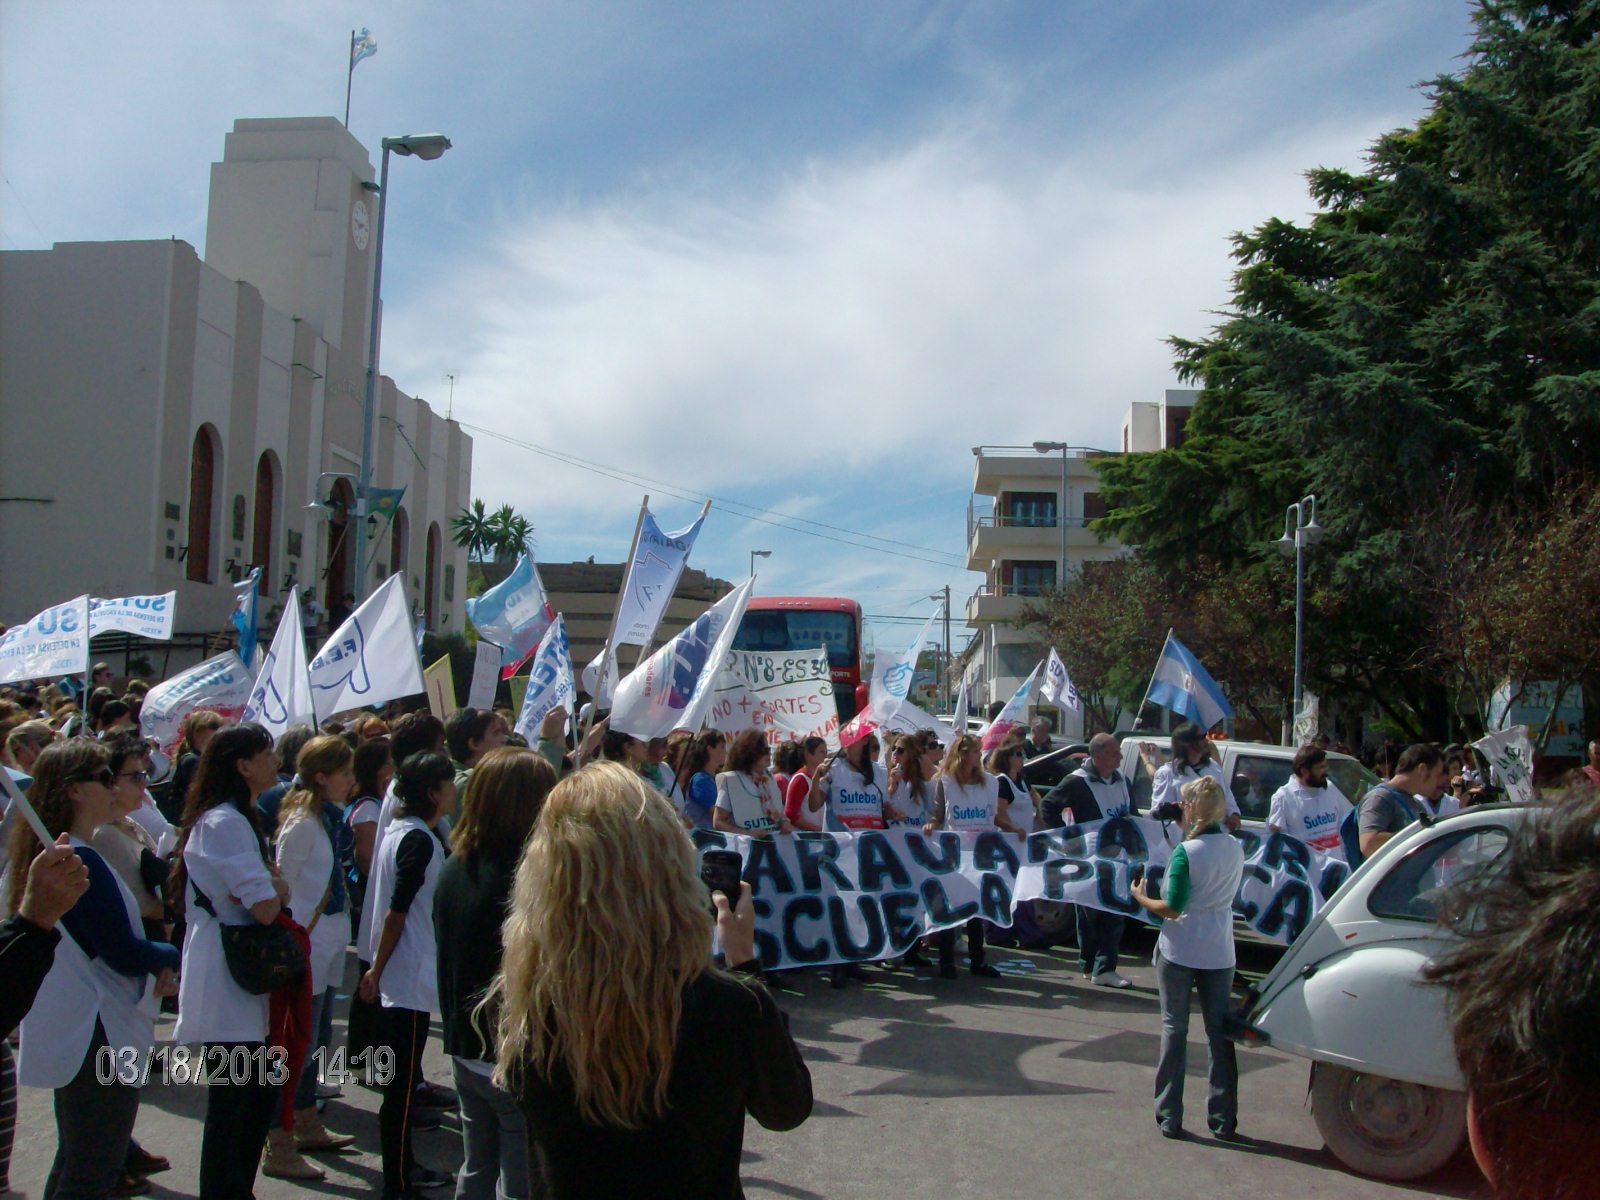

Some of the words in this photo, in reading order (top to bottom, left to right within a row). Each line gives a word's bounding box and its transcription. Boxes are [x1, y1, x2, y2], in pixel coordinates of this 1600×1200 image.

[712, 699, 732, 722] NO
[737, 694, 752, 714] +
[840, 788, 877, 804] Suteba
[952, 804, 986, 820] Suteba
[1303, 811, 1337, 830] Suteba
[720, 868, 1012, 968] SCUELA
